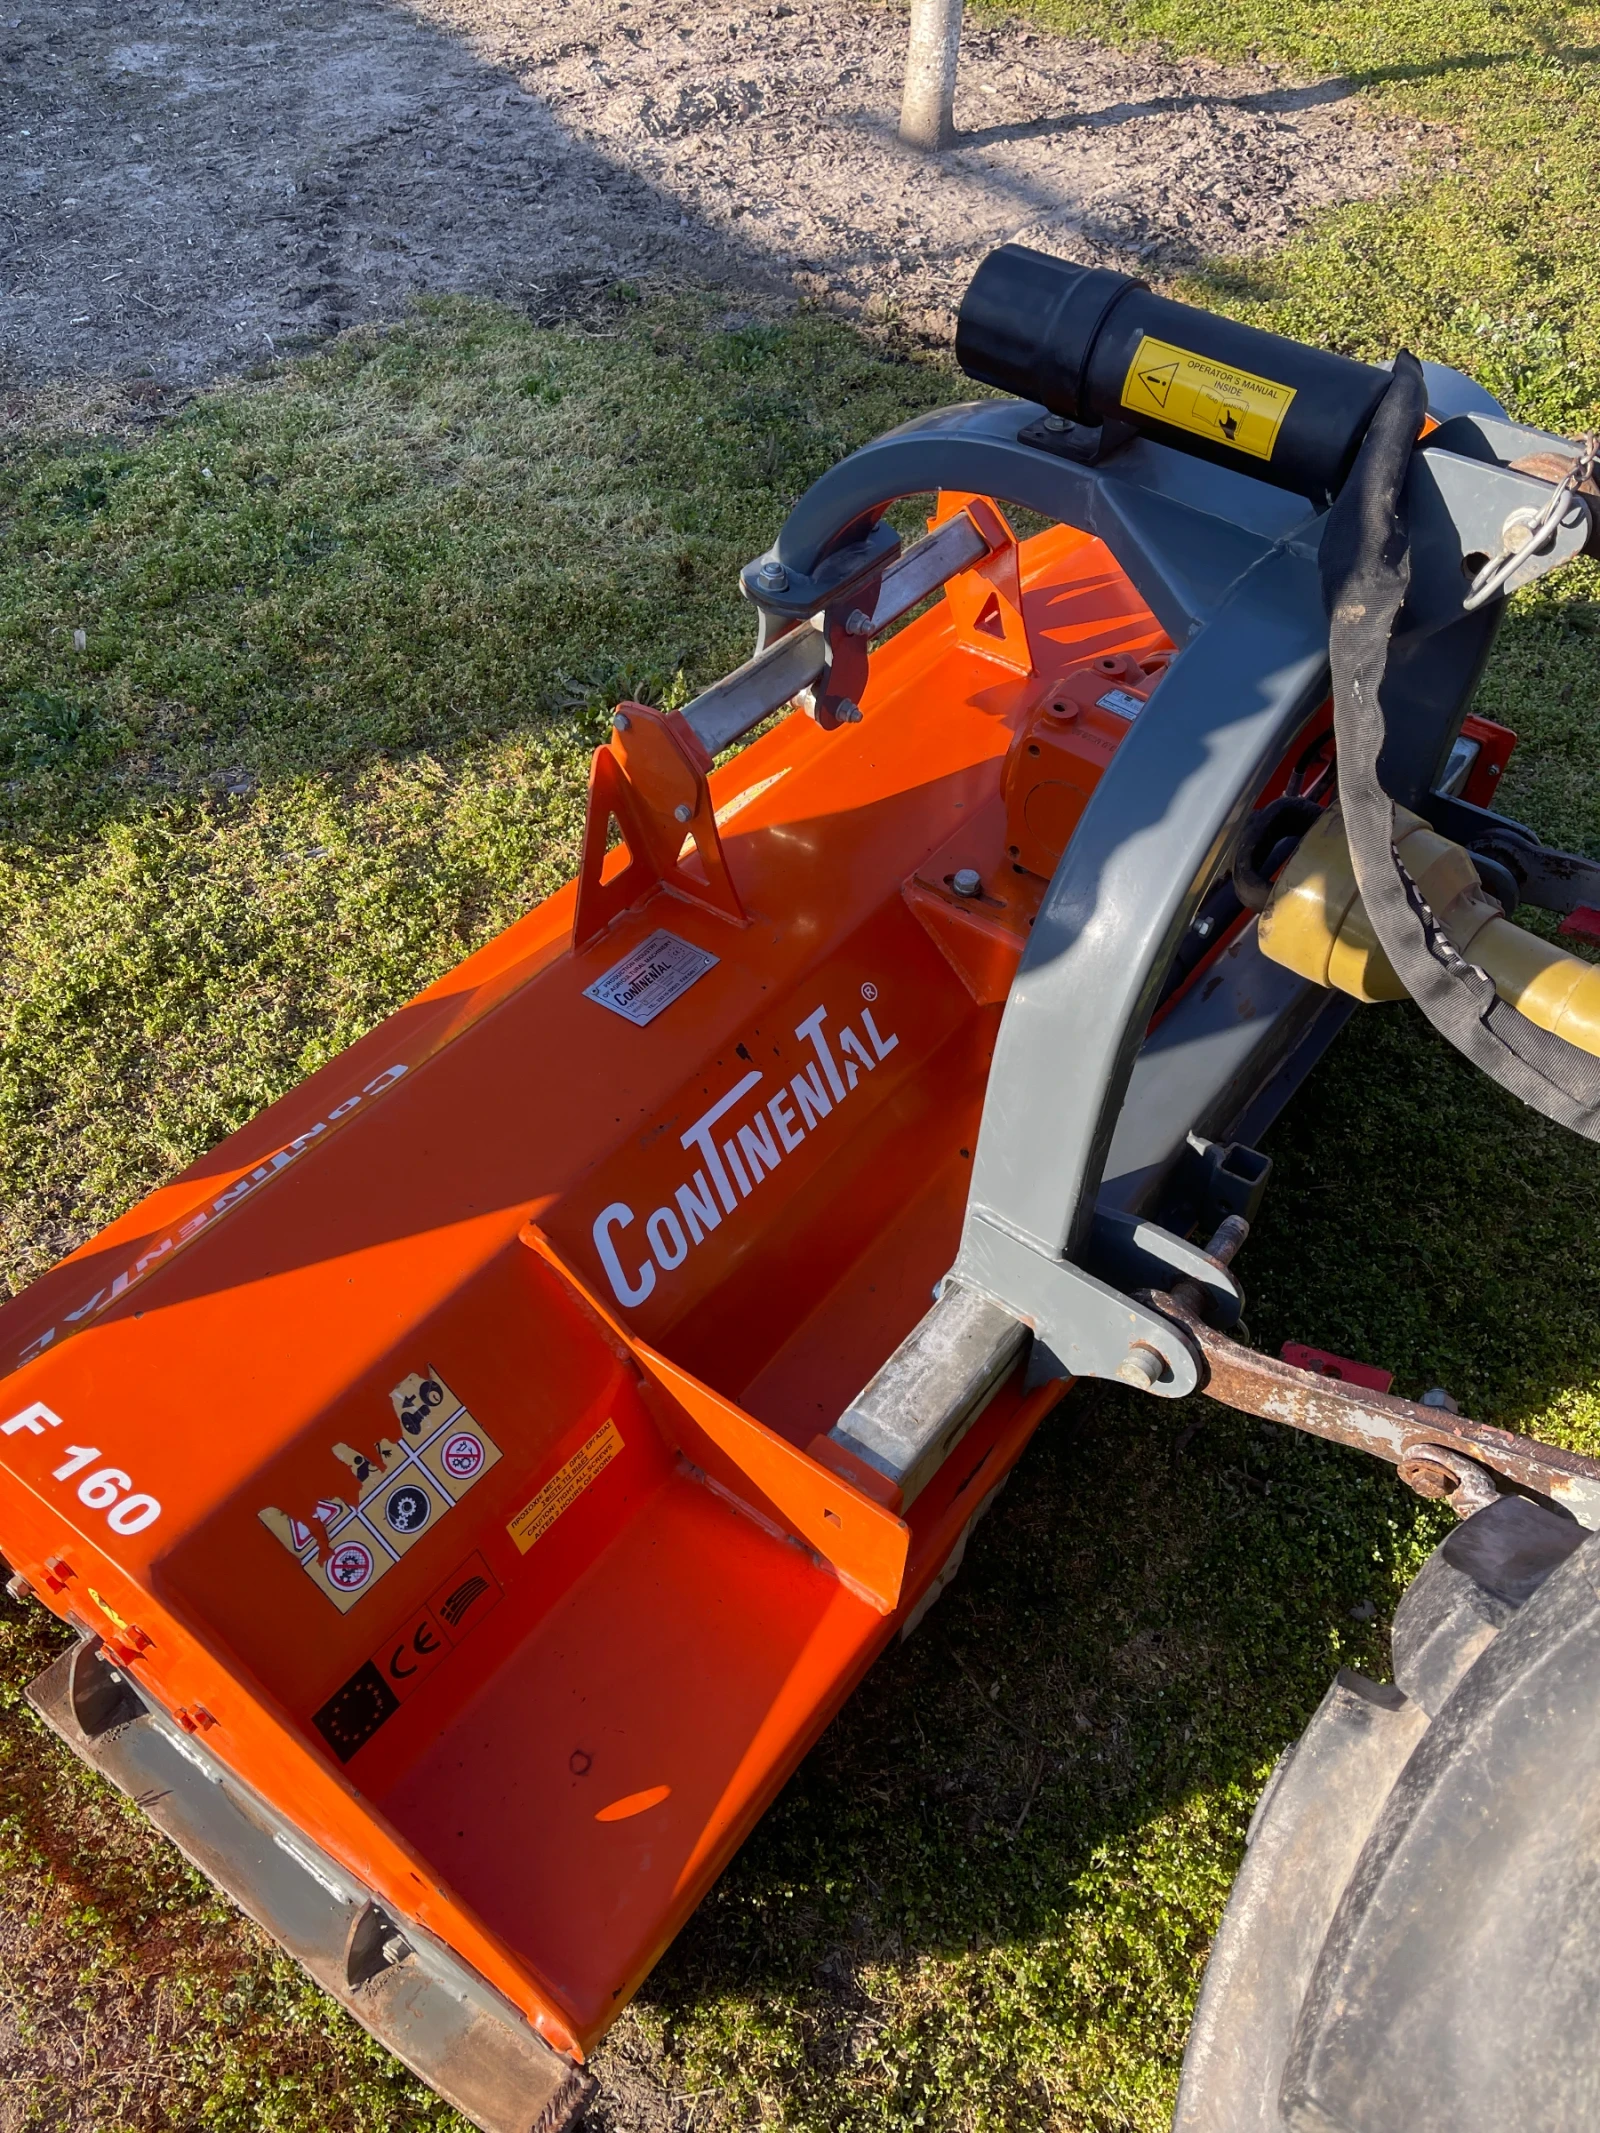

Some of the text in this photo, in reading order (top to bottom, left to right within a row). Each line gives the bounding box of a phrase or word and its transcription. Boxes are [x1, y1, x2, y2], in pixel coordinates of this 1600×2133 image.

[1187, 360, 1278, 399] OPERATOR'S MANUAL
[1214, 381, 1243, 397] INSIDE
[603, 960, 636, 988] PRODUCTION
[634, 943, 657, 962] INDUSTRY
[610, 962, 645, 991] AGRICULTURAL
[643, 940, 672, 963] MACHINERY
[613, 962, 672, 1006] CONTINENTAL
[593, 1004, 899, 1308] CONTINENTAL
[19, 1065, 408, 1358] CONTINENTAL
[1, 1401, 161, 1535] F 160
[556, 1485, 575, 1505] TIGHT
[575, 1471, 587, 1485] ALL
[586, 1444, 612, 1471] SCREWS
[534, 1516, 555, 1539] AFTER
[559, 1485, 583, 1510] HOURS
[583, 1474, 593, 1485] OF
[593, 1454, 613, 1474] WORK
